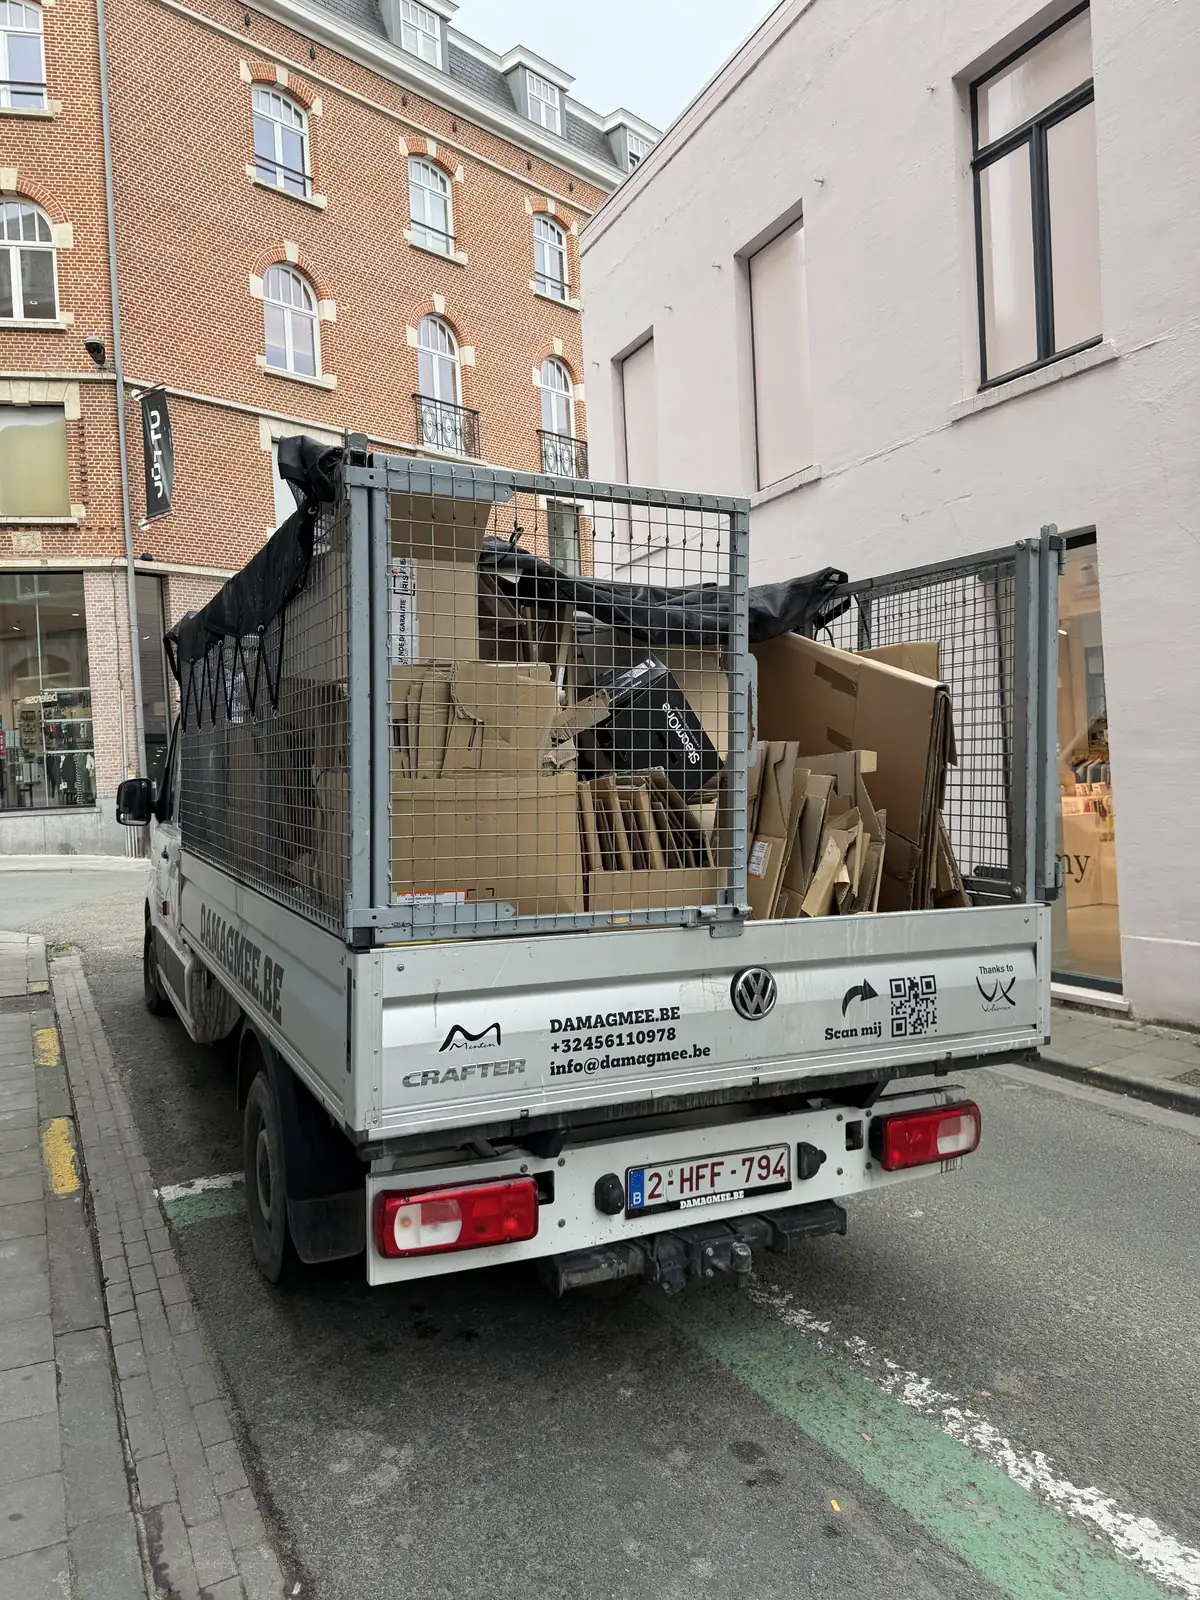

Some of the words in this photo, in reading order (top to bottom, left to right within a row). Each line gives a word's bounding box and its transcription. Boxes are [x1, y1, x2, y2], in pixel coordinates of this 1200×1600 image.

[200, 902, 285, 1026] DAMAGMEE.BE
[978, 964, 1006, 975] Thanks
[1006, 964, 1014, 973] to
[549, 1006, 681, 1034] DAMAGMEE.BE
[824, 1025, 858, 1041] Scan
[860, 1021, 883, 1038] mij
[550, 1027, 677, 1054] +32456110978
[402, 1058, 527, 1088] CRAFTER
[549, 1044, 711, 1076] info@damagmee.be
[633, 1191, 642, 1206] B
[679, 1190, 745, 1209] DAMAGMEE.BE
